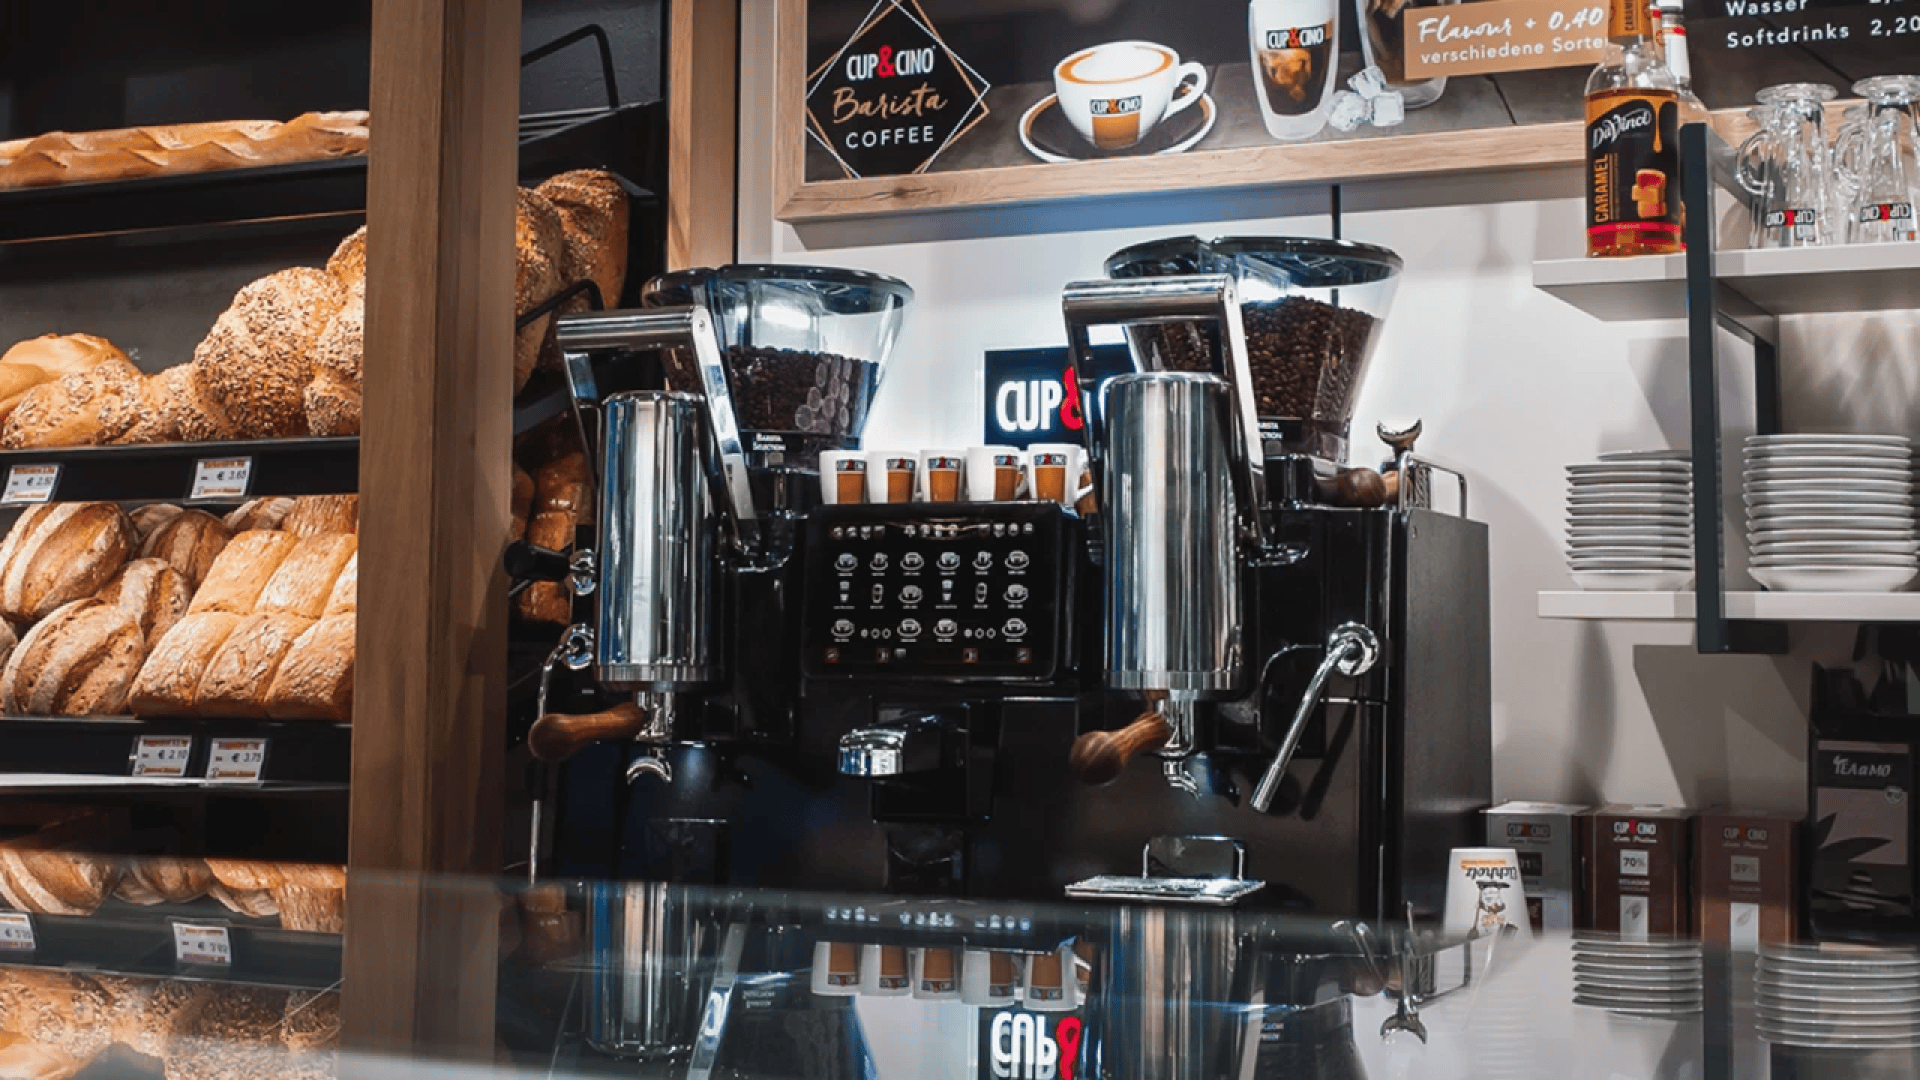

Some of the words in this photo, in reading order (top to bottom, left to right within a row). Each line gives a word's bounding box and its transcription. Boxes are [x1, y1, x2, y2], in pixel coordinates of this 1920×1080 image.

[1418, 15, 1512, 43] Flavour
[1525, 18, 1537, 29] +
[1548, 7, 1604, 31] 0,40
[1726, 0, 1807, 16] Wasser
[1268, 27, 1324, 48] CUP&CINO
[1727, 23, 1849, 48] Softdrinks
[1870, 14, 1920, 36] 2,20
[846, 45, 935, 82] CUP&CINO
[1421, 42, 1544, 64] verschiedene
[832, 82, 948, 124] Barista
[1091, 95, 1141, 114] CUP&CINO
[845, 125, 935, 148] COFFEE
[1593, 153, 1609, 223] CARAMEL
[996, 365, 1085, 432] CUP&
